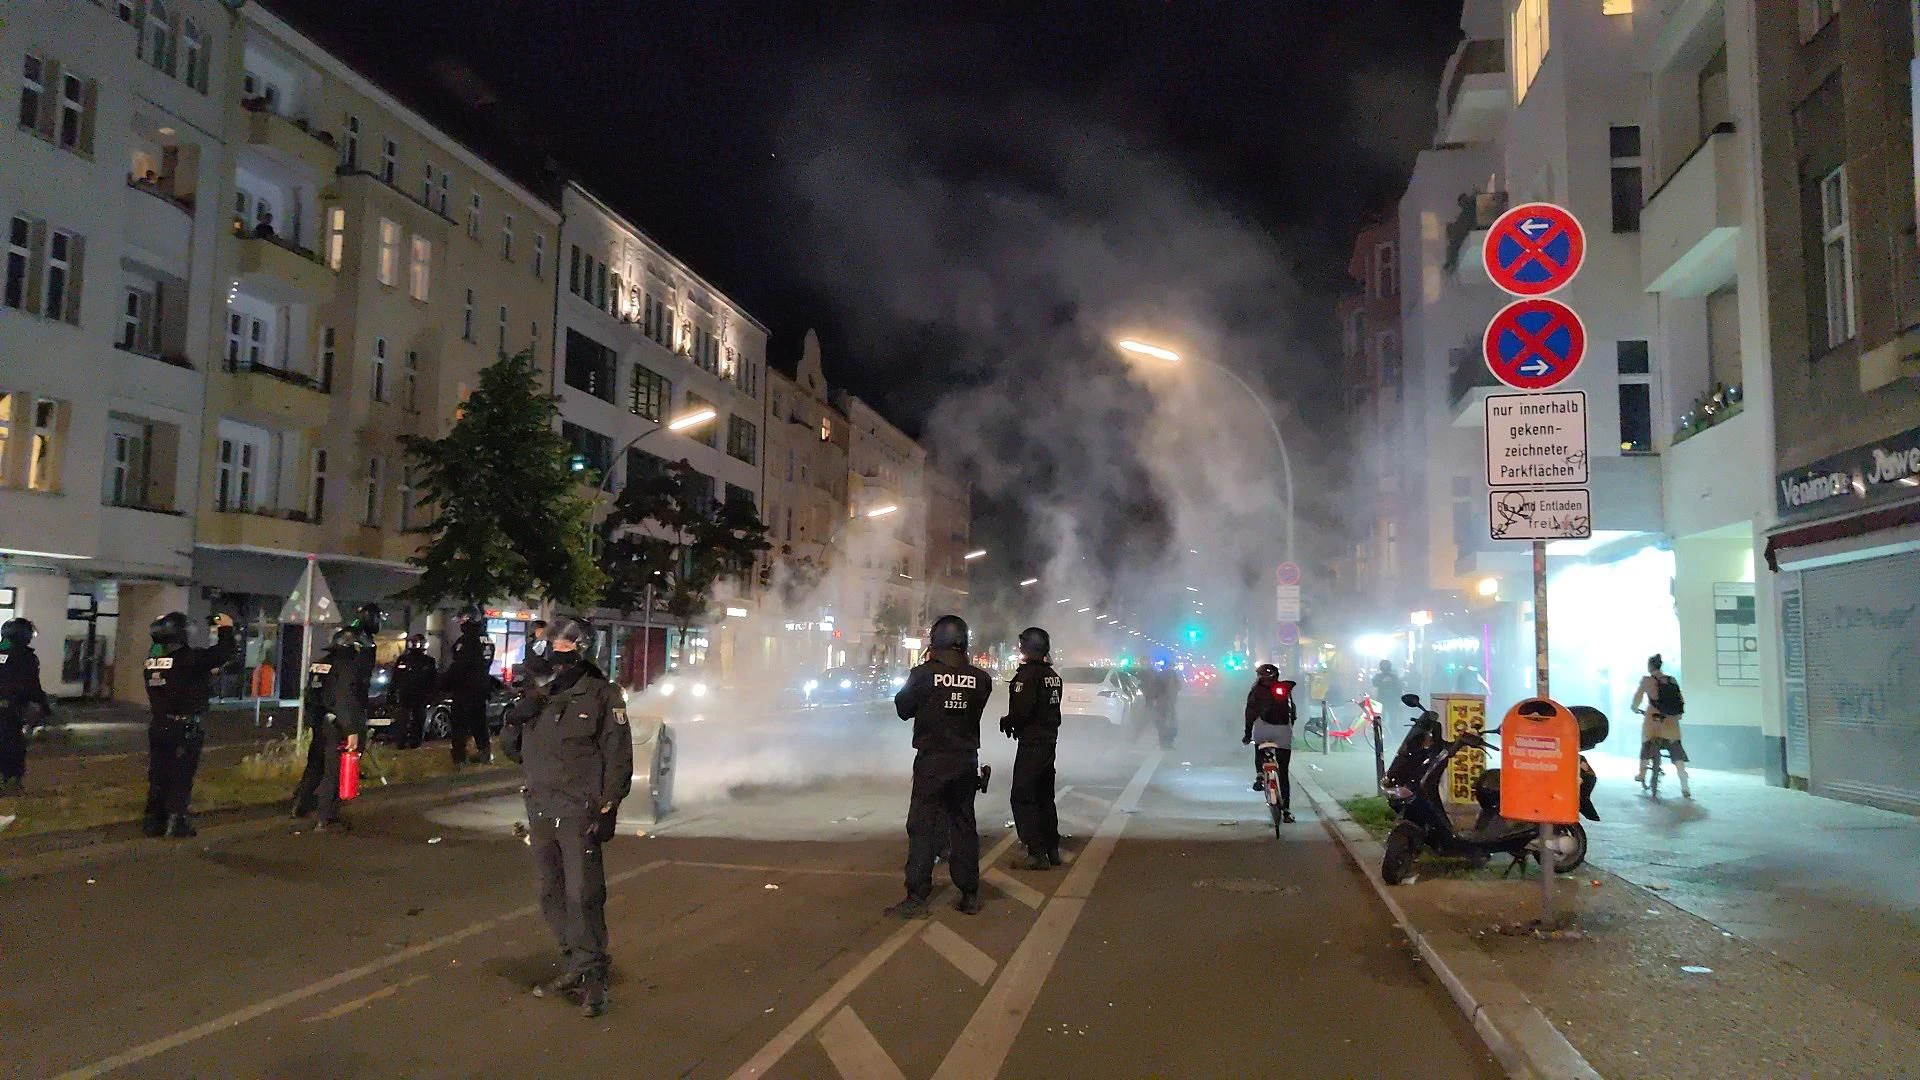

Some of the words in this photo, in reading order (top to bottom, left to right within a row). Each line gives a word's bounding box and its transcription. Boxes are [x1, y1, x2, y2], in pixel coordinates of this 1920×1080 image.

[1493, 406, 1513, 416] nur
[1519, 400, 1579, 415] innerhalb
[1510, 423, 1562, 440] gekenn-
[1504, 444, 1568, 457] zeichneter
[1500, 464, 1575, 478] Parkflächen
[1540, 500, 1582, 511] Entladen
[1528, 519, 1552, 529] frei
[934, 673, 977, 689] POLIZEI
[951, 692, 963, 701] BE
[944, 700, 968, 709] 13216
